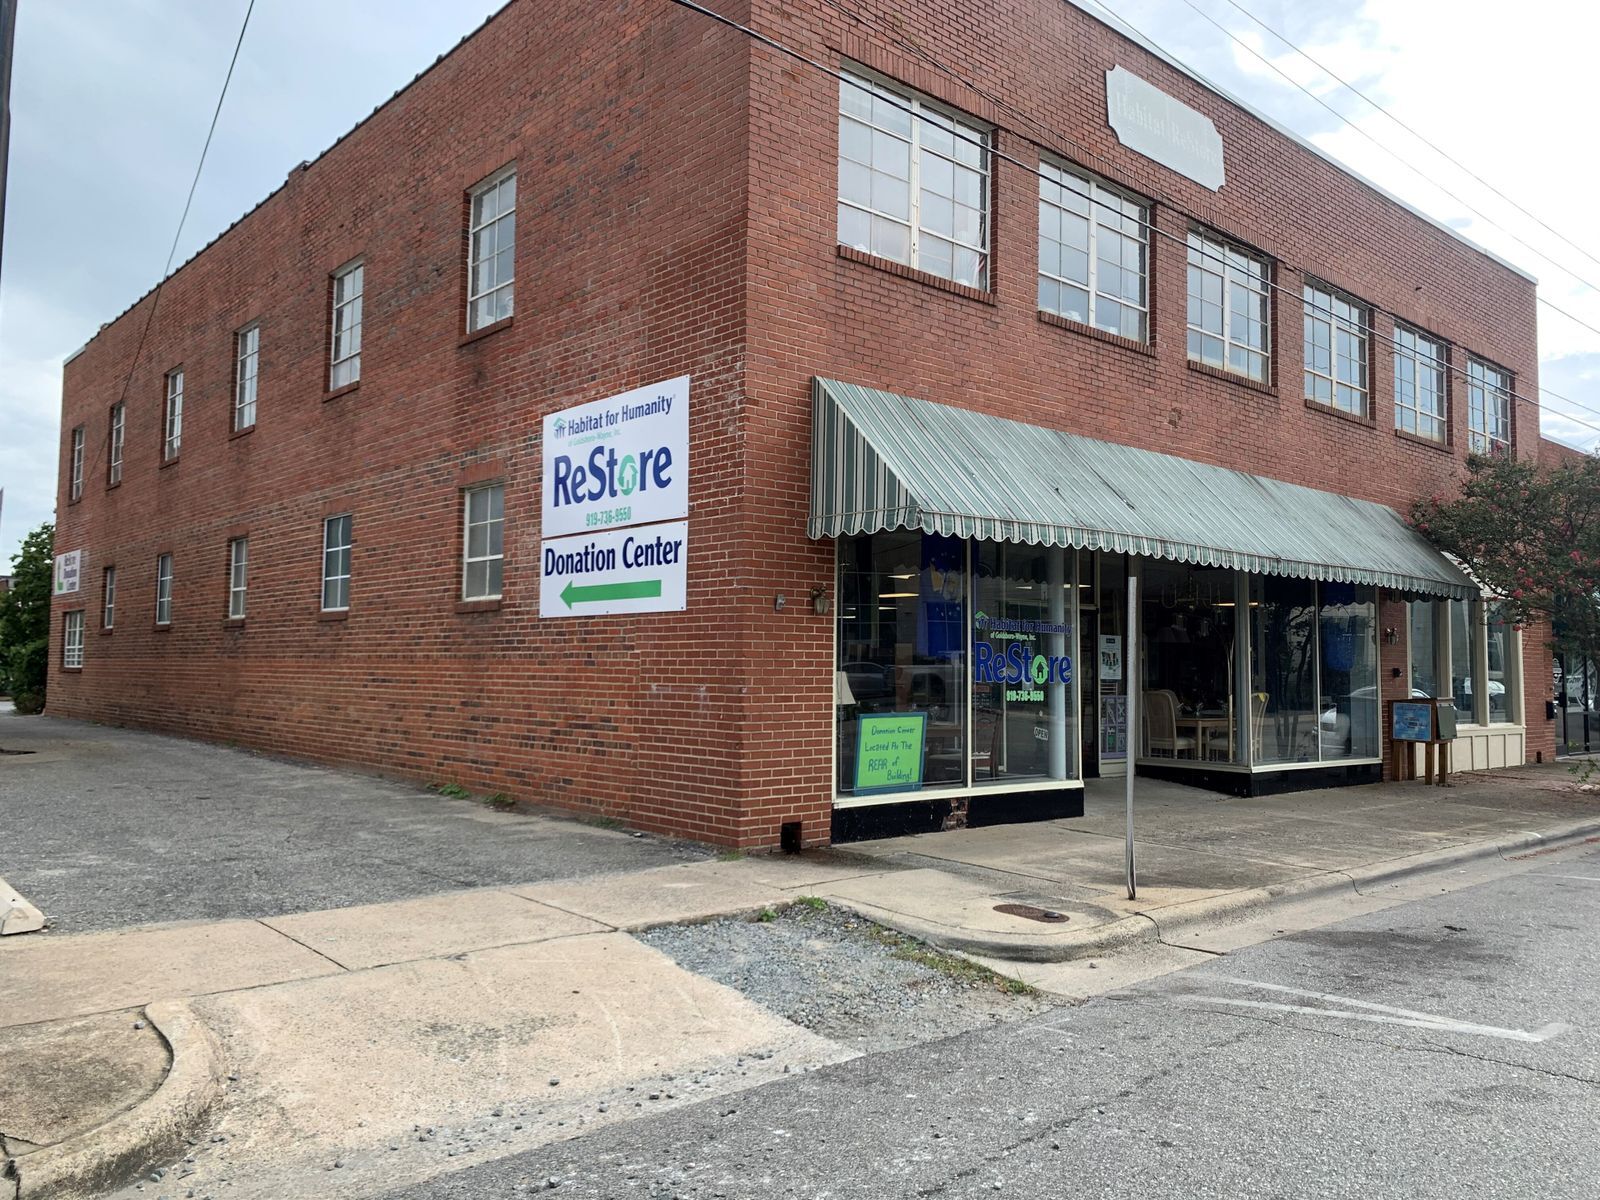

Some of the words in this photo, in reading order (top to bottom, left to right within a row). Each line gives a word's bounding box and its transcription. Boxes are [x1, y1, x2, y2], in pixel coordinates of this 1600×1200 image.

[567, 414, 603, 436] Habitat
[605, 410, 620, 426] for
[621, 395, 673, 422] Humanity
[553, 445, 673, 508] ReStore
[585, 506, 632, 527] 919-736-9550
[544, 542, 616, 577] Donation
[622, 536, 682, 569] Center
[990, 617, 1021, 631] Habitat
[1035, 620, 1073, 637] Humanity
[974, 641, 1072, 684] ReStore
[1034, 728, 1048, 740] OPEN
[864, 742, 890, 752] Located
[900, 741, 912, 750] The
[868, 758, 888, 772] REAR
[892, 756, 900, 766] of
